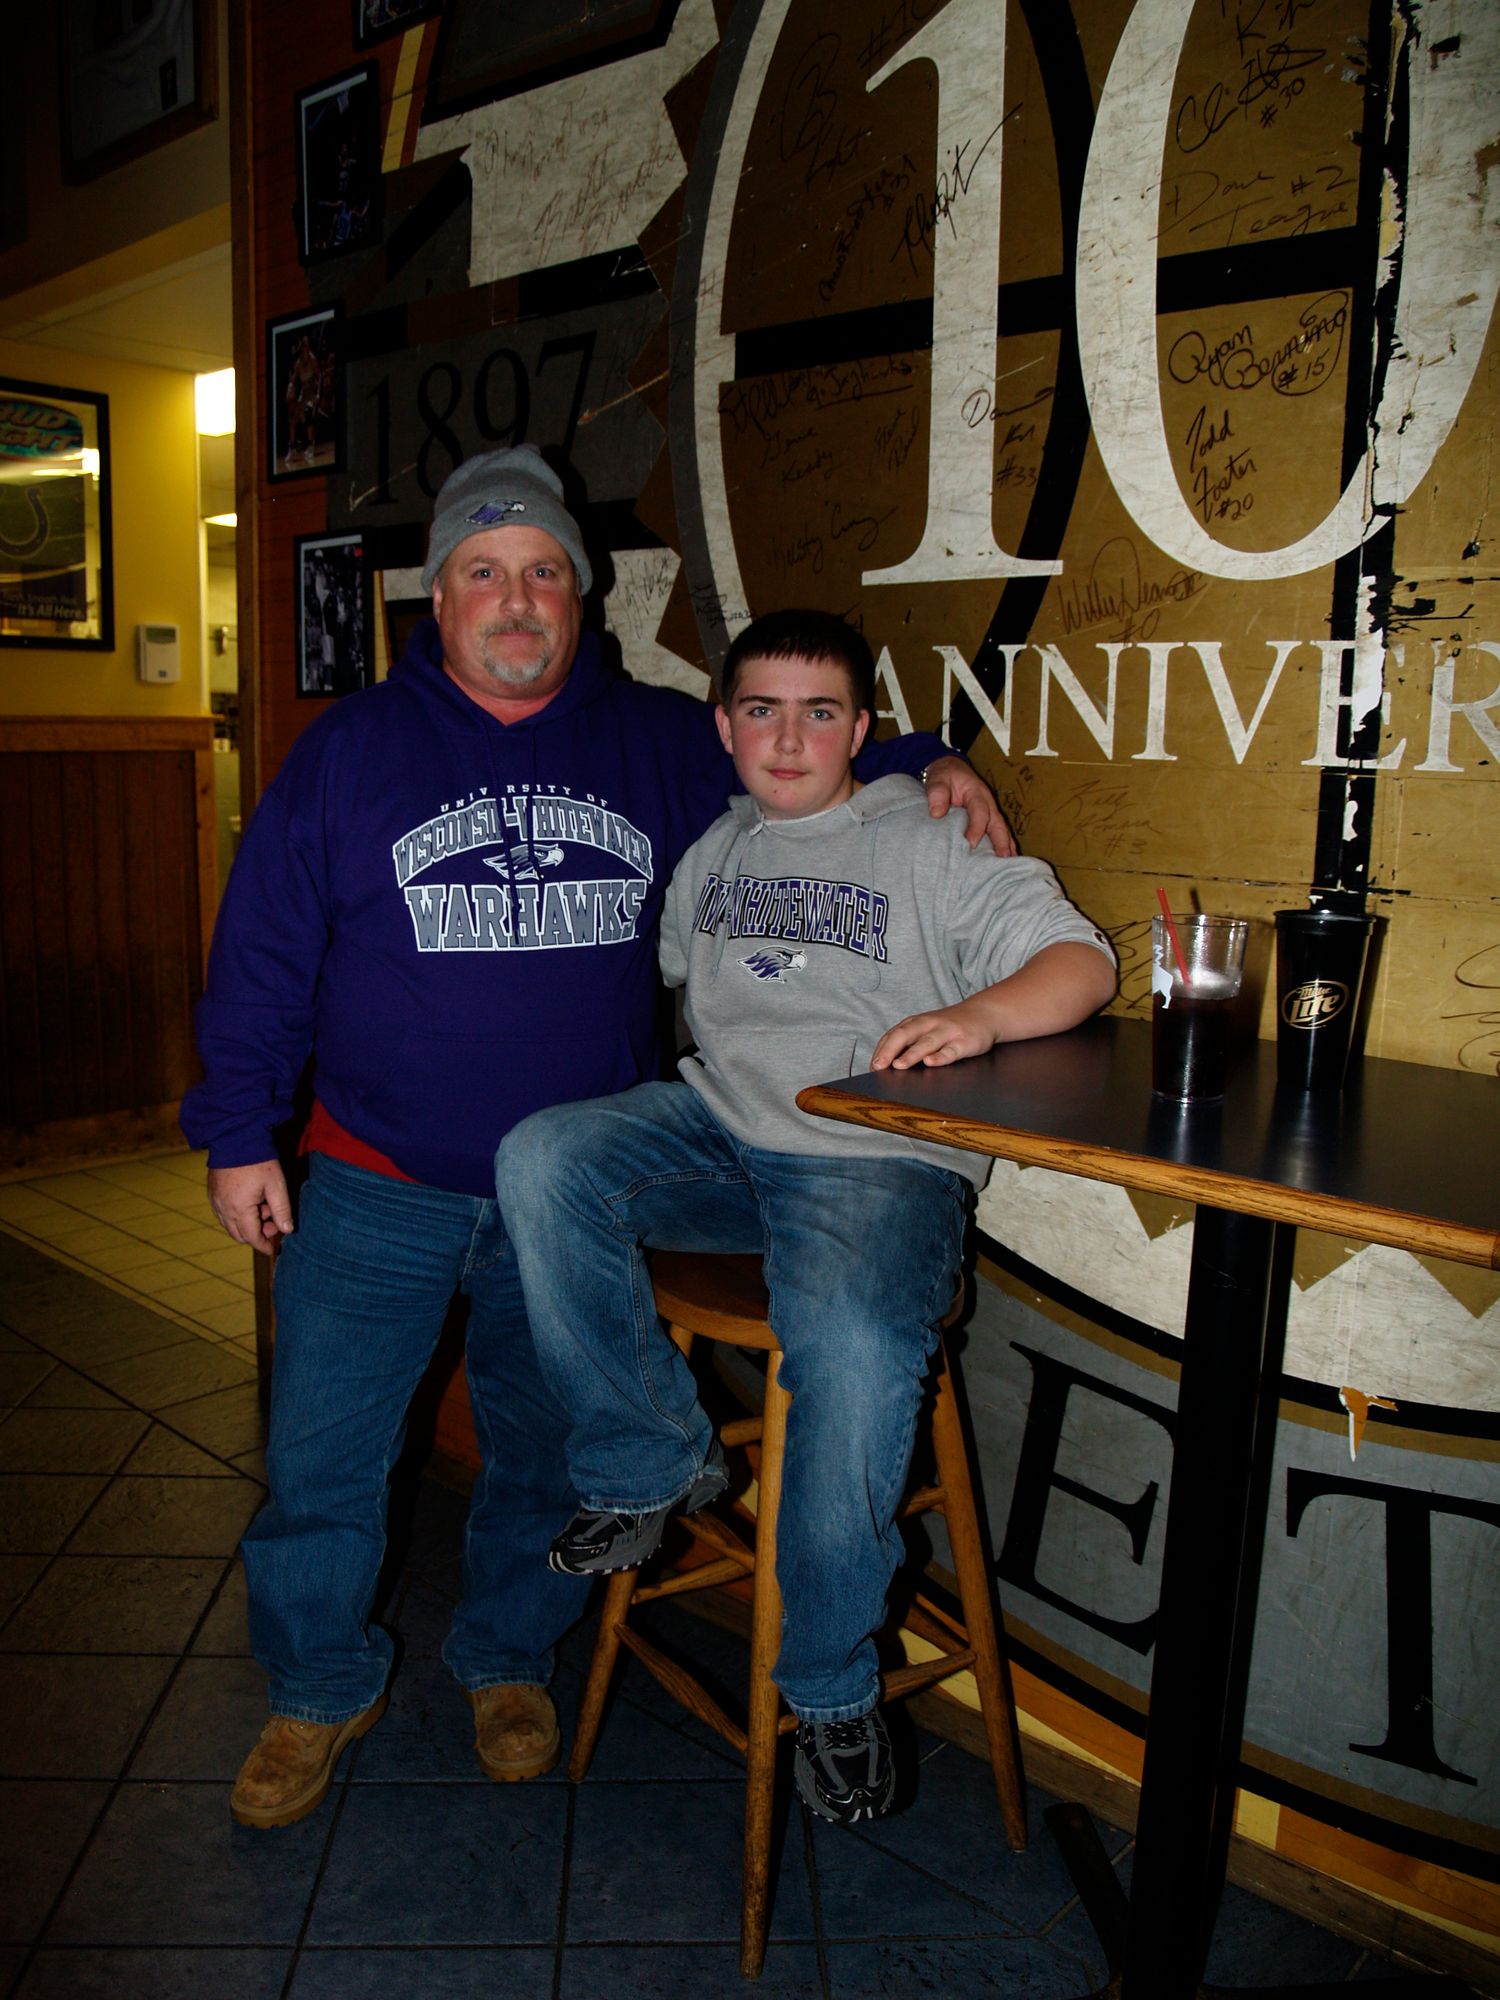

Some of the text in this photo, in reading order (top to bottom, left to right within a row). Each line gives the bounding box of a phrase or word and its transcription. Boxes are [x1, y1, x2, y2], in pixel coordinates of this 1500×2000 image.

[368, 331, 597, 507] 1897
[440, 784, 608, 813] UNIVRSITY OF
[404, 878, 648, 952] WARHAWKS
[1289, 994, 1341, 1023] Lite
